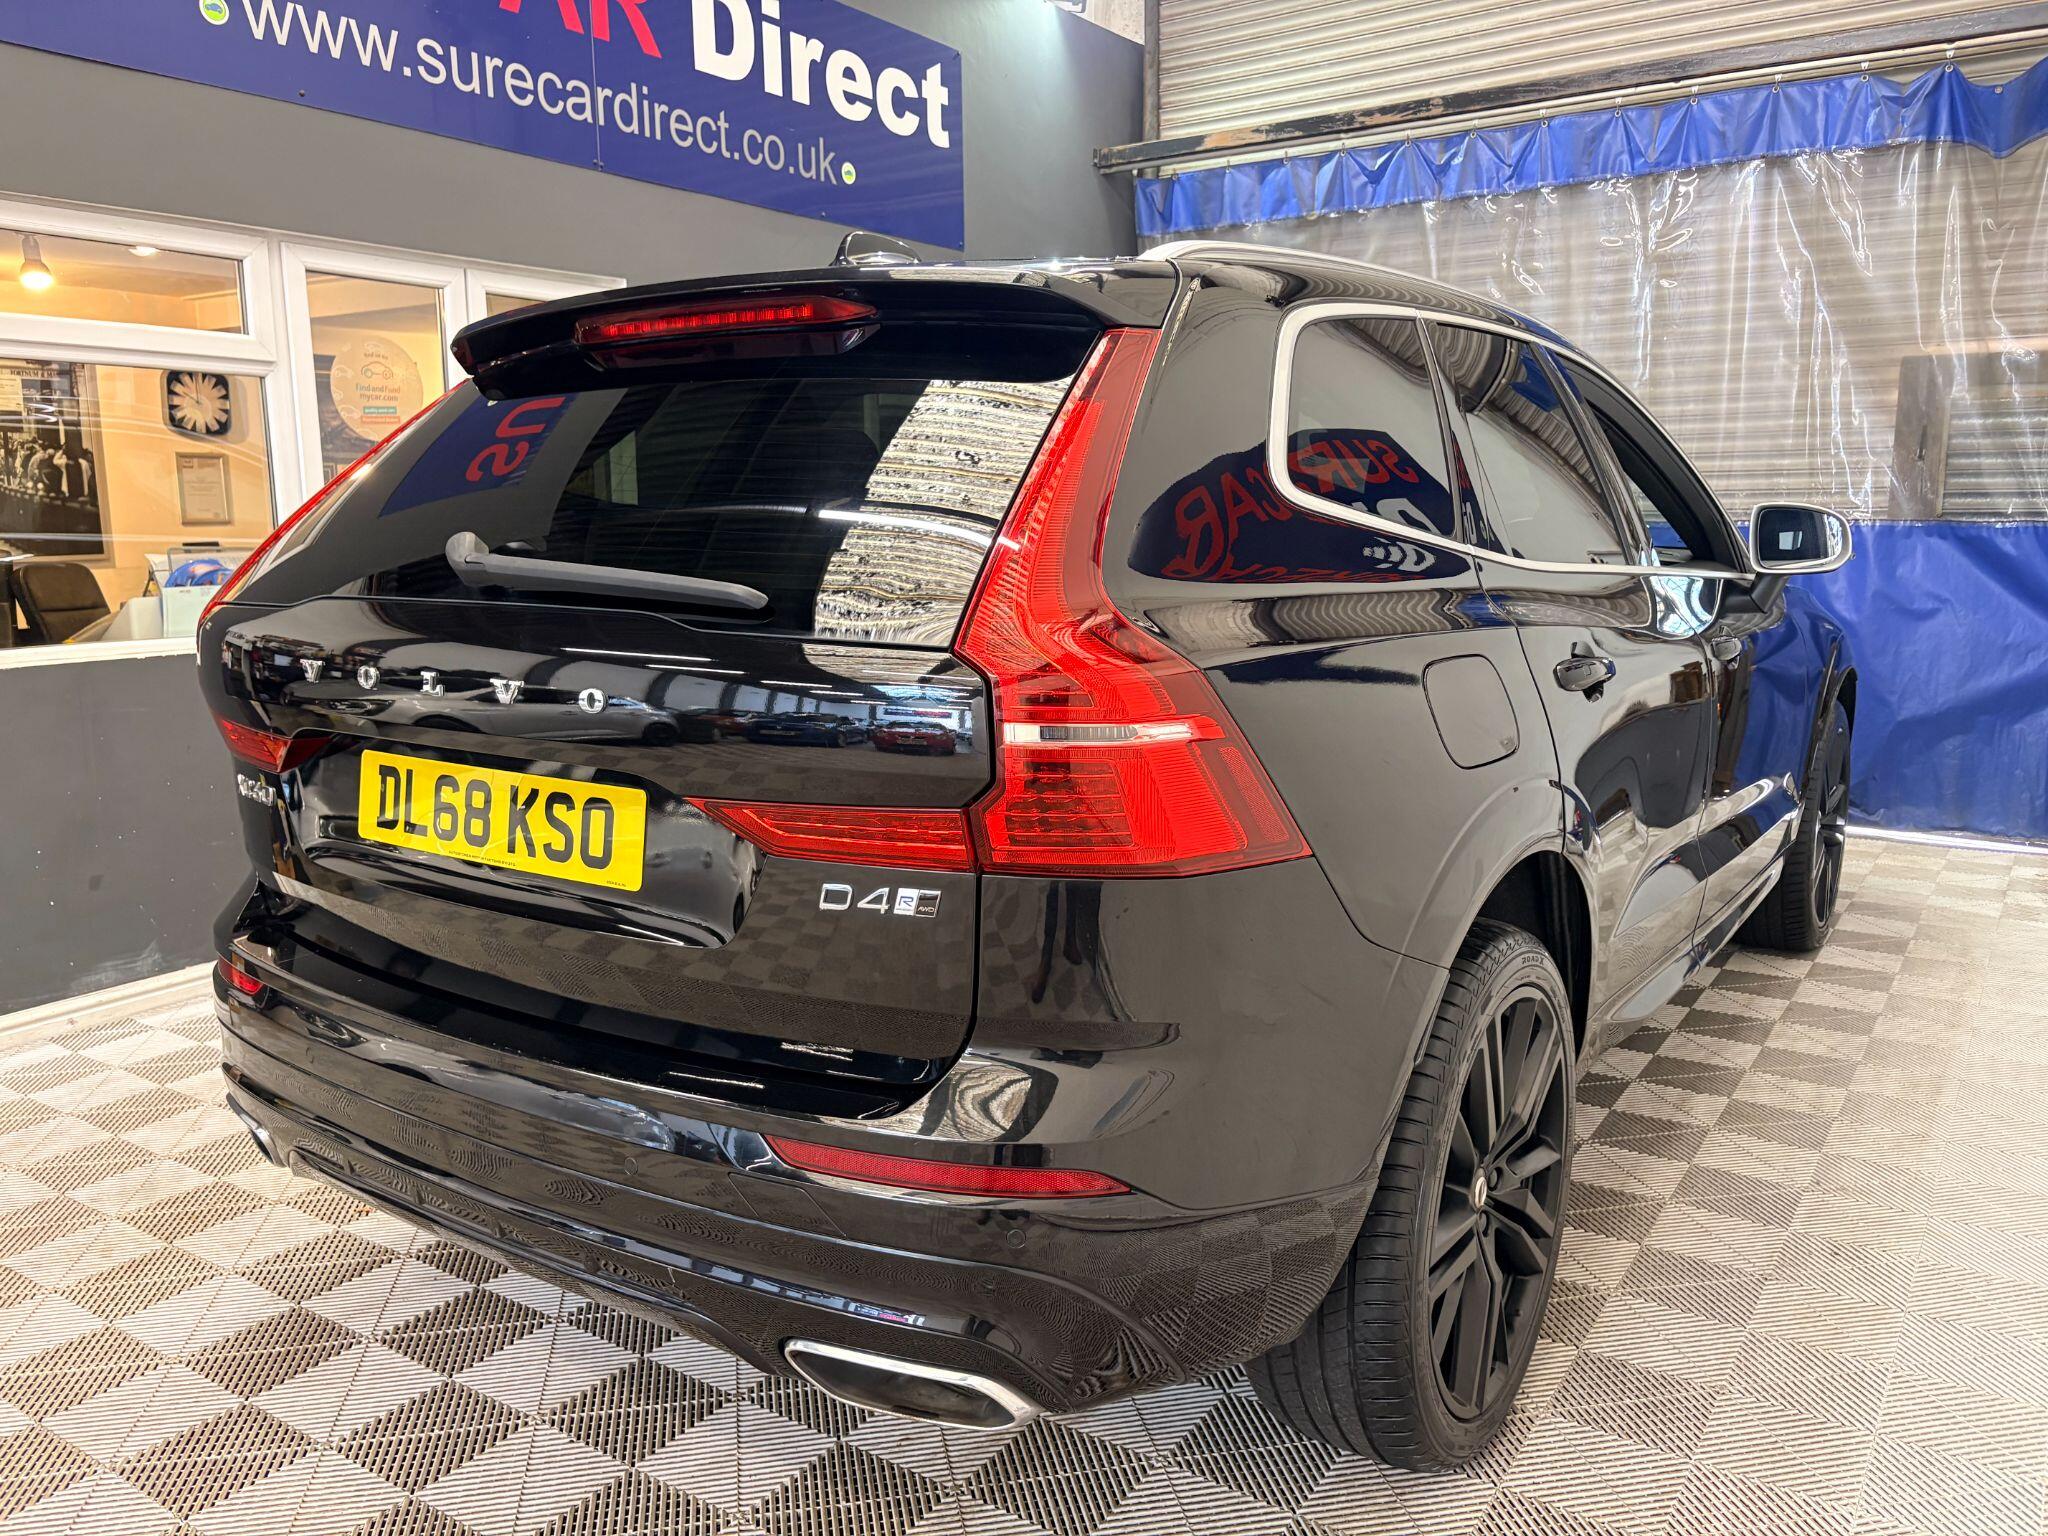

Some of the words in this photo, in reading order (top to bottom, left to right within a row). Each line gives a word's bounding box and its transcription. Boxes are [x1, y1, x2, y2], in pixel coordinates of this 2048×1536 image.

[242, 0, 838, 185] www.surecardirect.co.uk
[691, 0, 949, 148] Direct
[300, 658, 607, 715] VOLVO
[376, 764, 493, 848] DL68
[507, 784, 615, 870] KSO
[819, 883, 890, 914] D4
